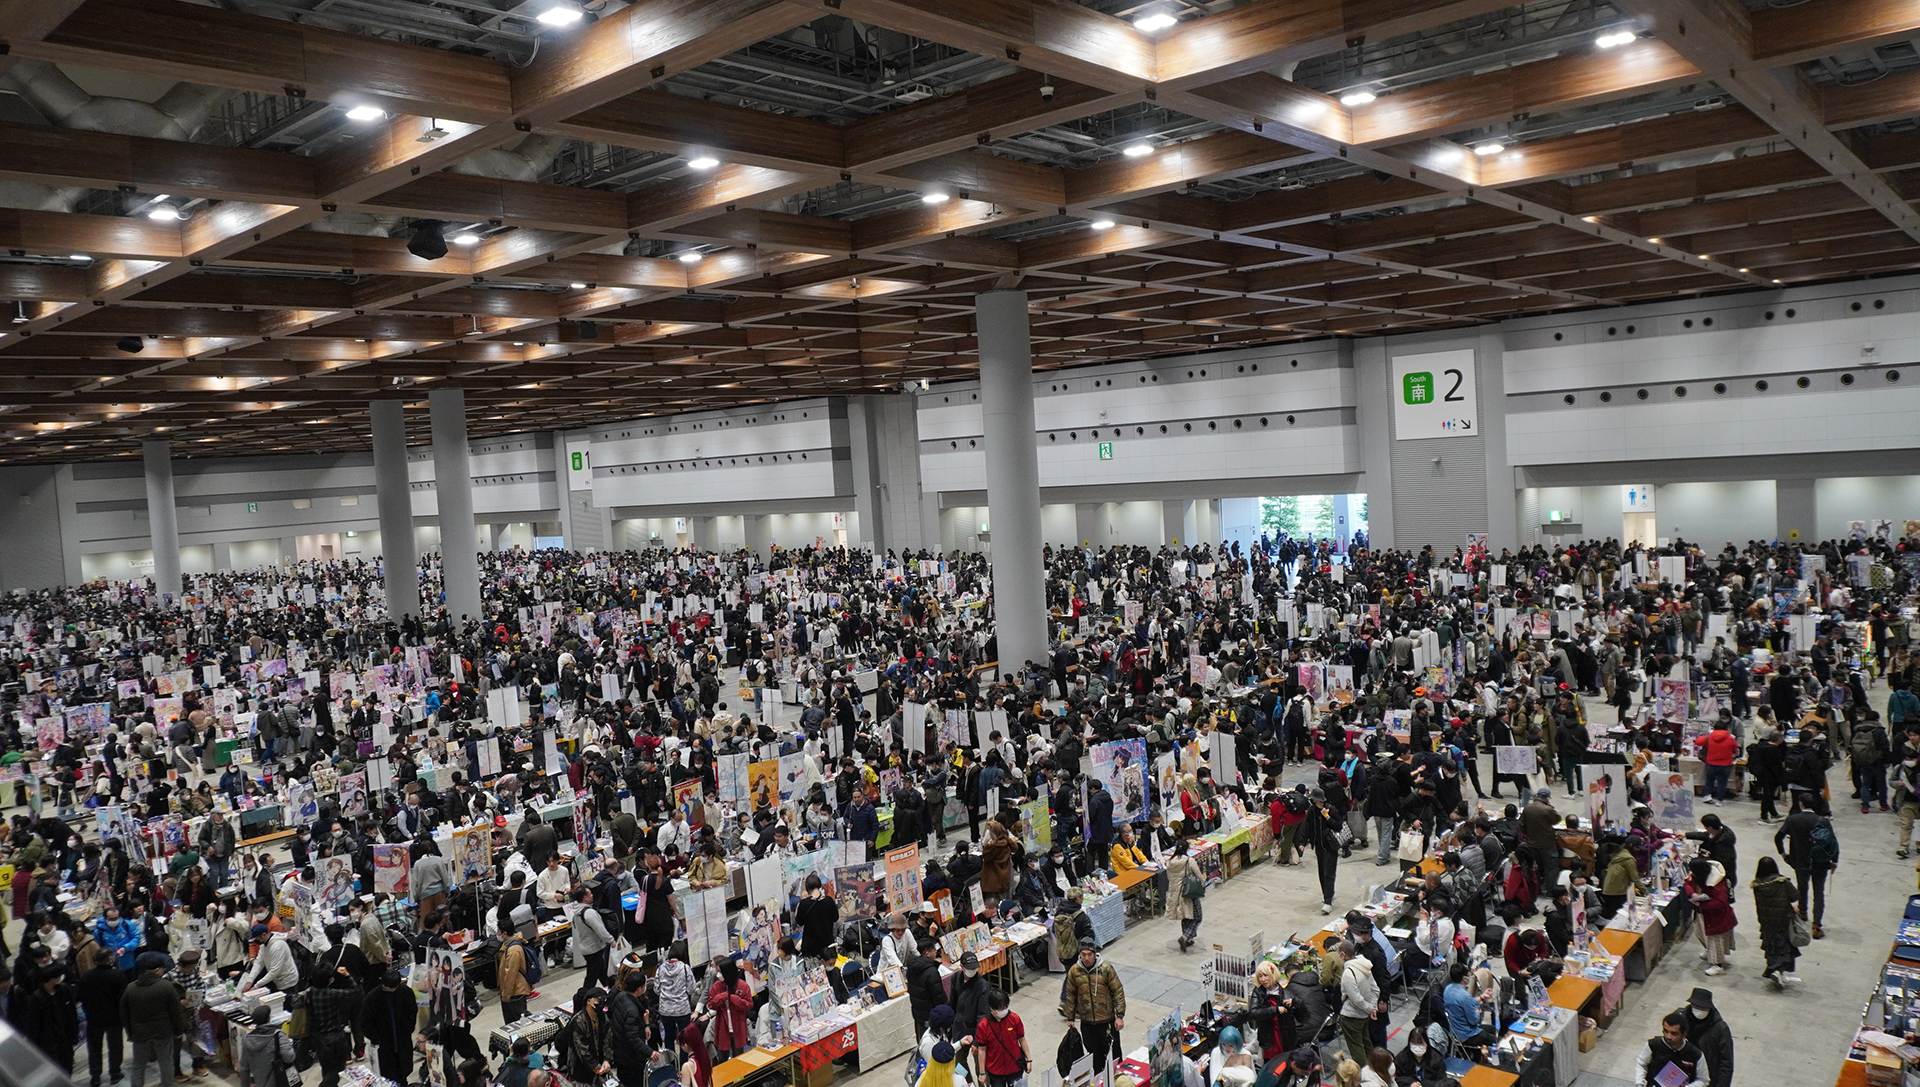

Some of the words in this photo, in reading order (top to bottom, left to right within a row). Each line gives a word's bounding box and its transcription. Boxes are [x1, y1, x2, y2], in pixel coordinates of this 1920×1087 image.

[1411, 384, 1426, 402] 南
[1444, 369, 1464, 402] 2
[585, 451, 590, 470] 1
